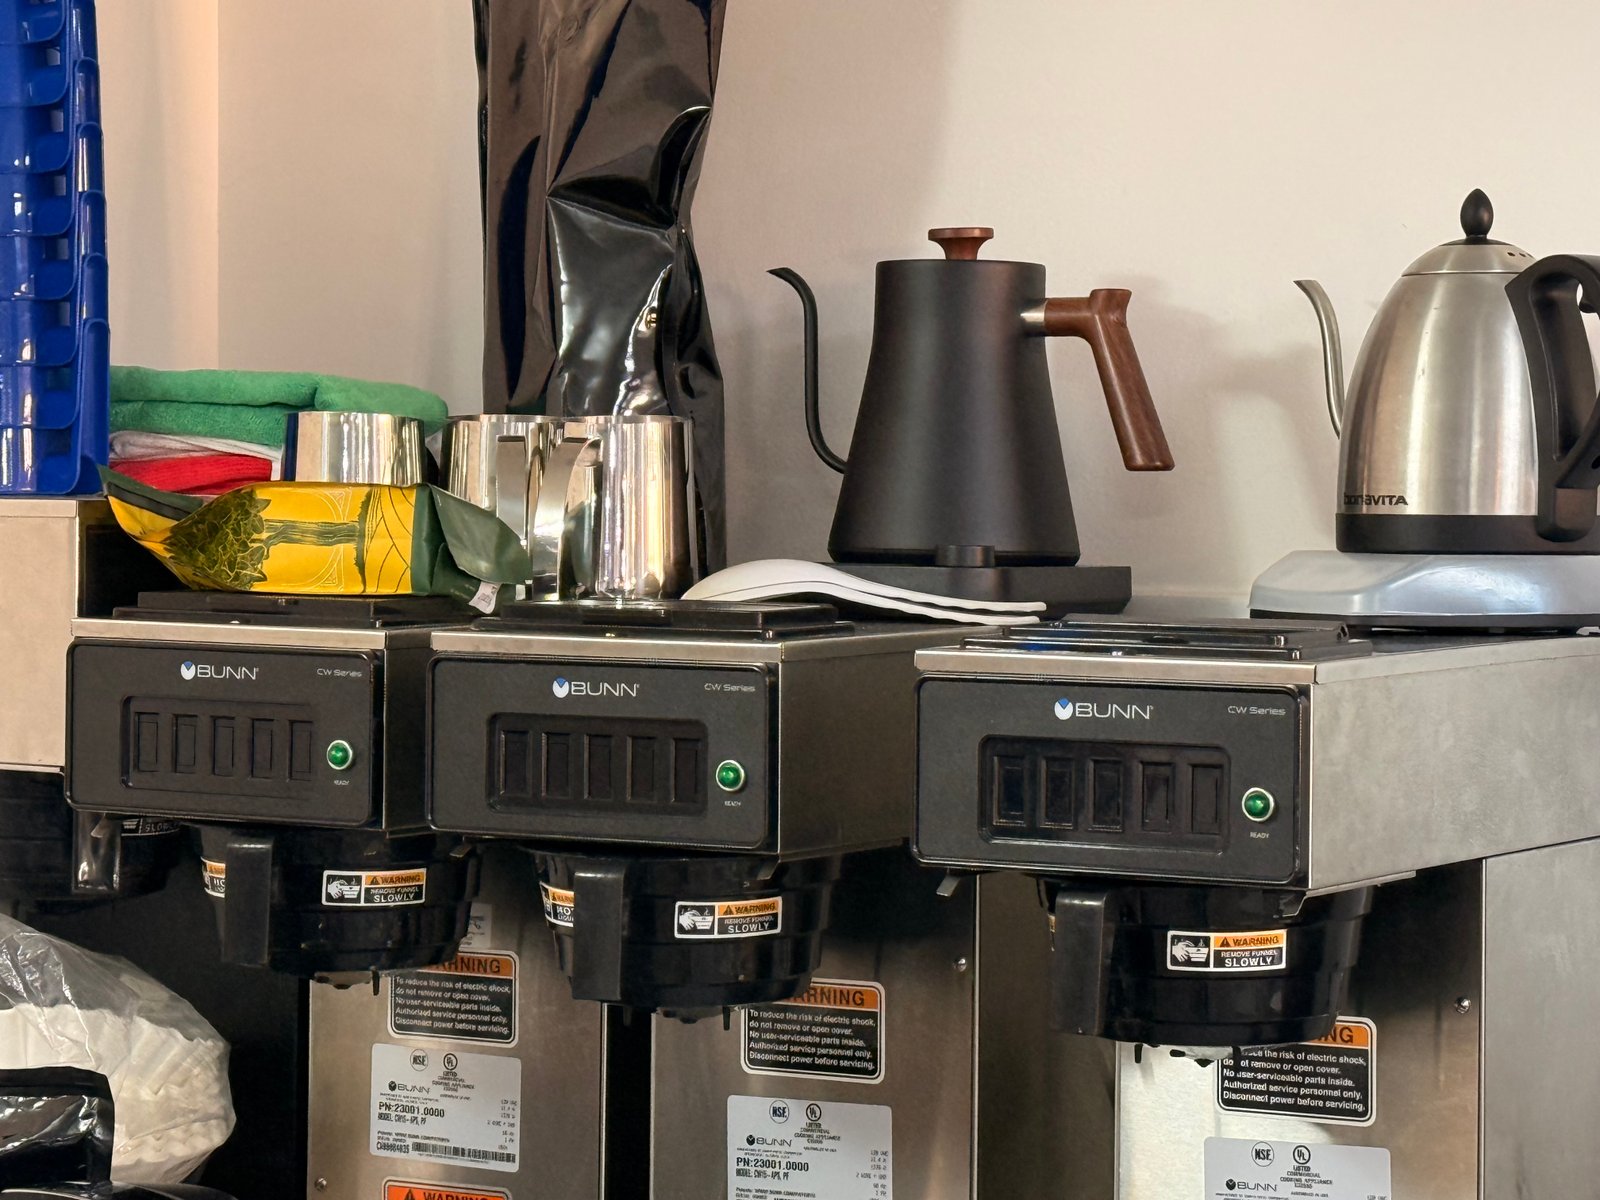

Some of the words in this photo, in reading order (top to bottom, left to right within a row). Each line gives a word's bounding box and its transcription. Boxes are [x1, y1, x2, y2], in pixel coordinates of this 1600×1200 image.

[197, 665, 257, 680] BUNN
[317, 668, 332, 676] CW
[334, 669, 362, 678] Series
[571, 681, 637, 697] BUNN
[704, 683, 721, 692] CW
[723, 684, 756, 693] Series
[1076, 702, 1151, 720] BUNN
[1228, 706, 1247, 714] CW
[1249, 706, 1286, 716] Series
[381, 874, 420, 884] WARNING
[374, 893, 414, 903] SLOWLY
[735, 902, 776, 914] WARNING
[728, 922, 770, 934] SLOWLY
[1233, 936, 1279, 946] WARNING
[1224, 957, 1273, 967] SLOWLY
[760, 1011, 784, 1019] reduce
[822, 1016, 849, 1025] electric
[852, 1018, 876, 1026] shock,
[812, 1026, 829, 1034] open
[762, 1032, 819, 1043] user-serviceable
[842, 1039, 865, 1047] inside.
[750, 1042, 788, 1051] Authorized
[790, 1045, 815, 1053] service
[817, 1048, 853, 1056] personnel
[855, 1050, 872, 1058] only.
[750, 1052, 789, 1061] Disconnect
[791, 1056, 812, 1064] power
[815, 1057, 838, 1066] before
[840, 1060, 874, 1070] servicing.
[1265, 1050, 1278, 1059] the
[1307, 1054, 1337, 1063] electric
[1339, 1056, 1366, 1065] shock,
[1251, 1061, 1281, 1069] remove
[1293, 1064, 1313, 1072] open
[1316, 1066, 1341, 1074] cover.
[1223, 1069, 1234, 1077] No
[1305, 1077, 1325, 1085] parts
[1328, 1078, 1355, 1087] inside.
[398, 1084, 430, 1094] BUNN
[1224, 1080, 1267, 1090] Authorized
[1269, 1085, 1298, 1093] service
[1301, 1088, 1341, 1097] personnel
[1343, 1090, 1362, 1099] only.
[1223, 1091, 1268, 1102] Disconnect
[1270, 1096, 1295, 1104] power
[1298, 1097, 1323, 1107] before
[1326, 1101, 1365, 1112] servicing.
[379, 1102, 445, 1118] PN:23001.0000
[756, 1137, 792, 1147] BUNN
[1255, 1149, 1272, 1160] NSF
[736, 1157, 809, 1172] PN:23001.0000
[1238, 1182, 1277, 1192] BUNN
